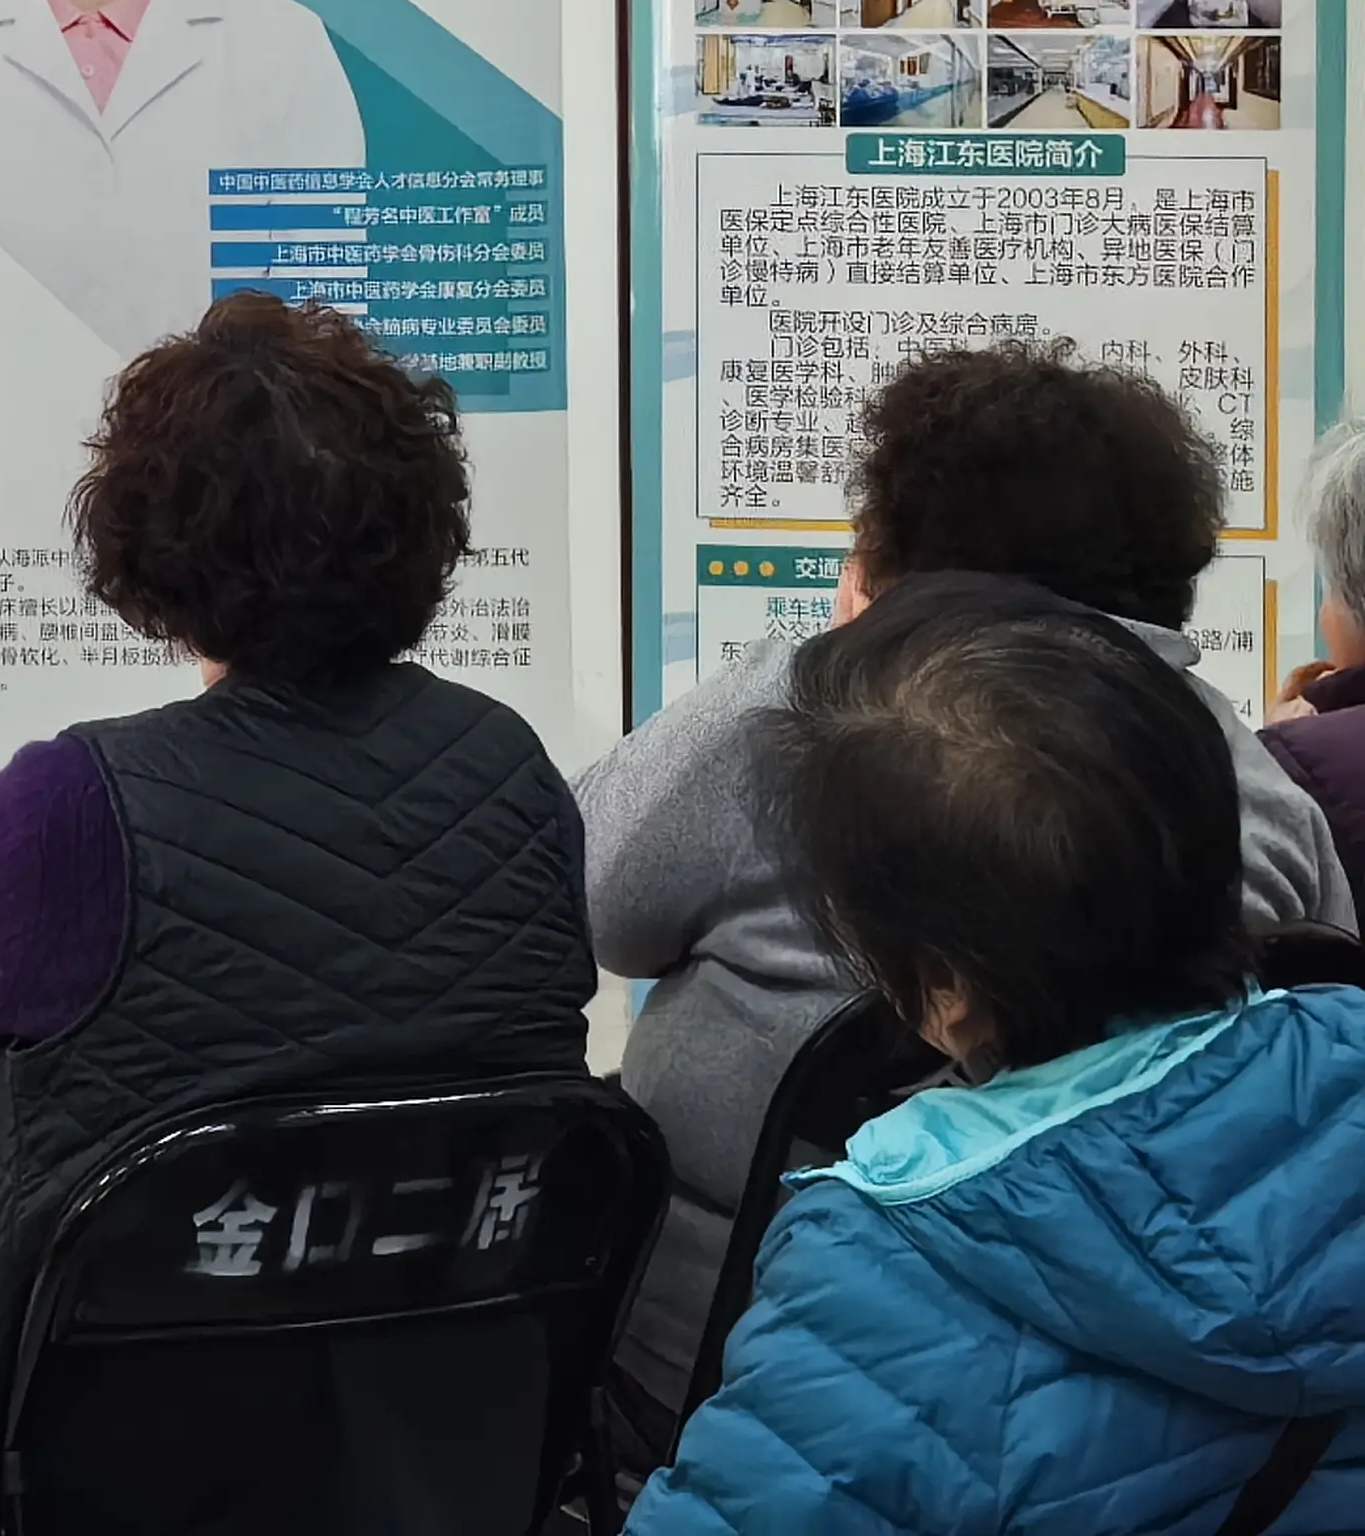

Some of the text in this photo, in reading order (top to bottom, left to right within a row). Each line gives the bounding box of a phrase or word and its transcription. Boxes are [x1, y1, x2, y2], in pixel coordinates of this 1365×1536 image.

[868, 138, 1103, 170] 上海江东医院简介
[720, 285, 781, 308] 单位。
[1179, 366, 1255, 390] 皮肤科
[721, 460, 866, 484] 环境温馨舒
[721, 483, 780, 508] 齐全。
[794, 556, 841, 579] 交通
